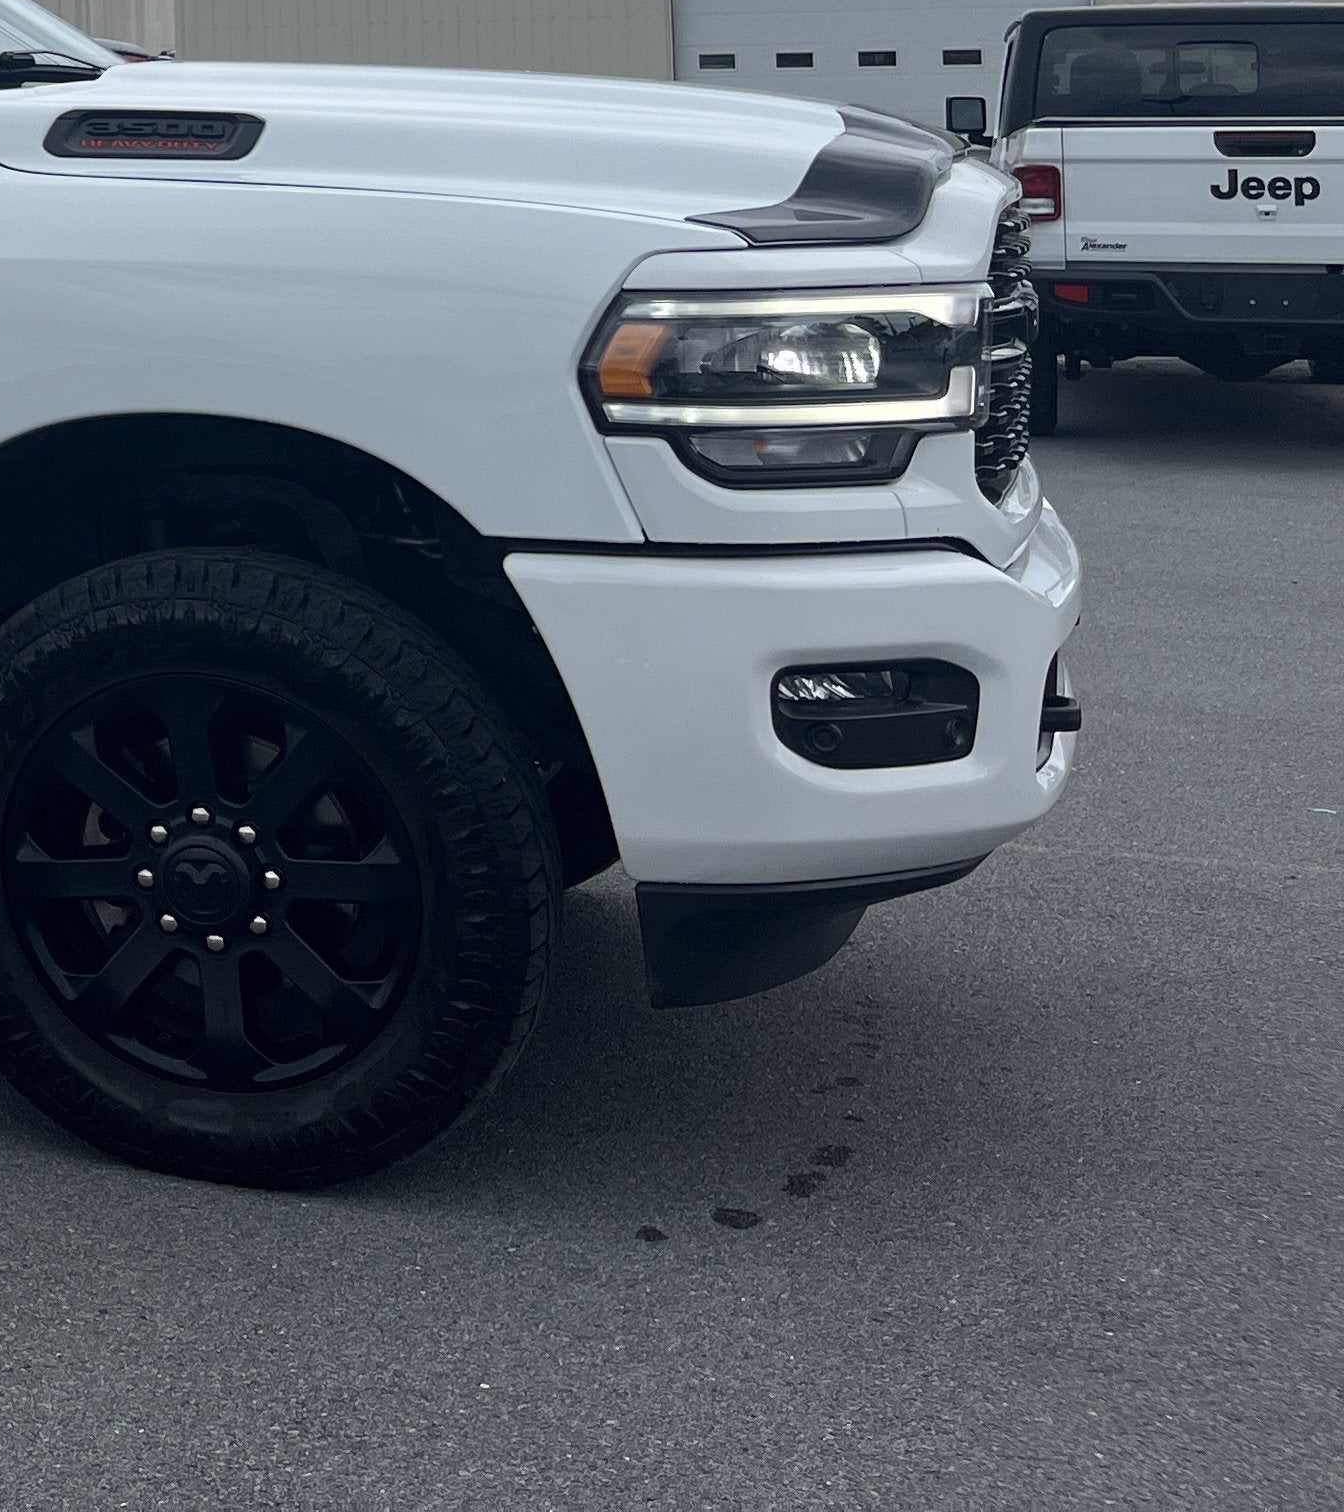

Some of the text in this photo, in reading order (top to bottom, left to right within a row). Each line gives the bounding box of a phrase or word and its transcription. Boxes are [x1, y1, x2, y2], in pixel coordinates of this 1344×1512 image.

[84, 120, 226, 139] 3500
[80, 138, 220, 151] HEAVY DUTY
[1210, 169, 1321, 207] Jeep
